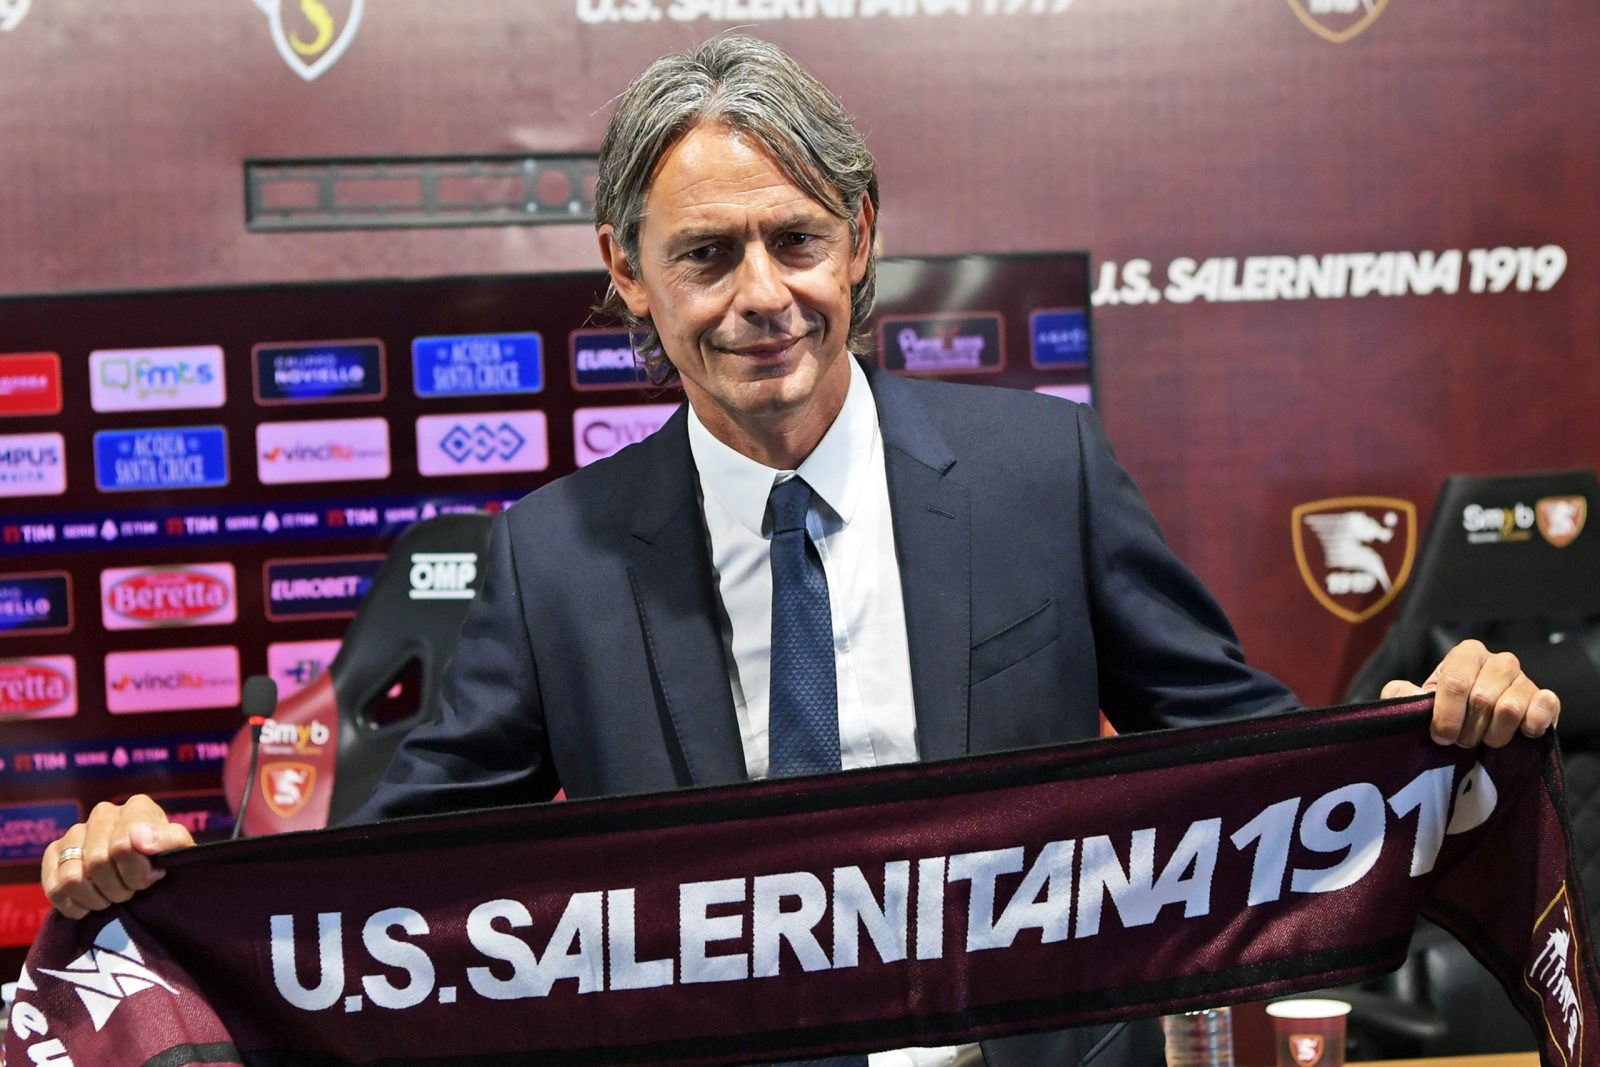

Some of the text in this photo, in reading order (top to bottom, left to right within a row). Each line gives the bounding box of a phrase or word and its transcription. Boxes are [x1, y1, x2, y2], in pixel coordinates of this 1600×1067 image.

[1163, 248, 1463, 304] SALERNITANA
[1467, 244, 1568, 294] 1919
[136, 357, 214, 385] fmts
[1463, 502, 1535, 535] Smyb
[271, 575, 358, 601] EUROBET
[409, 561, 477, 591] OMP
[114, 583, 223, 614] Beretta
[259, 717, 330, 749] Smyb
[270, 907, 457, 1013] U.S.
[466, 817, 1221, 1001] SALERNITANA
